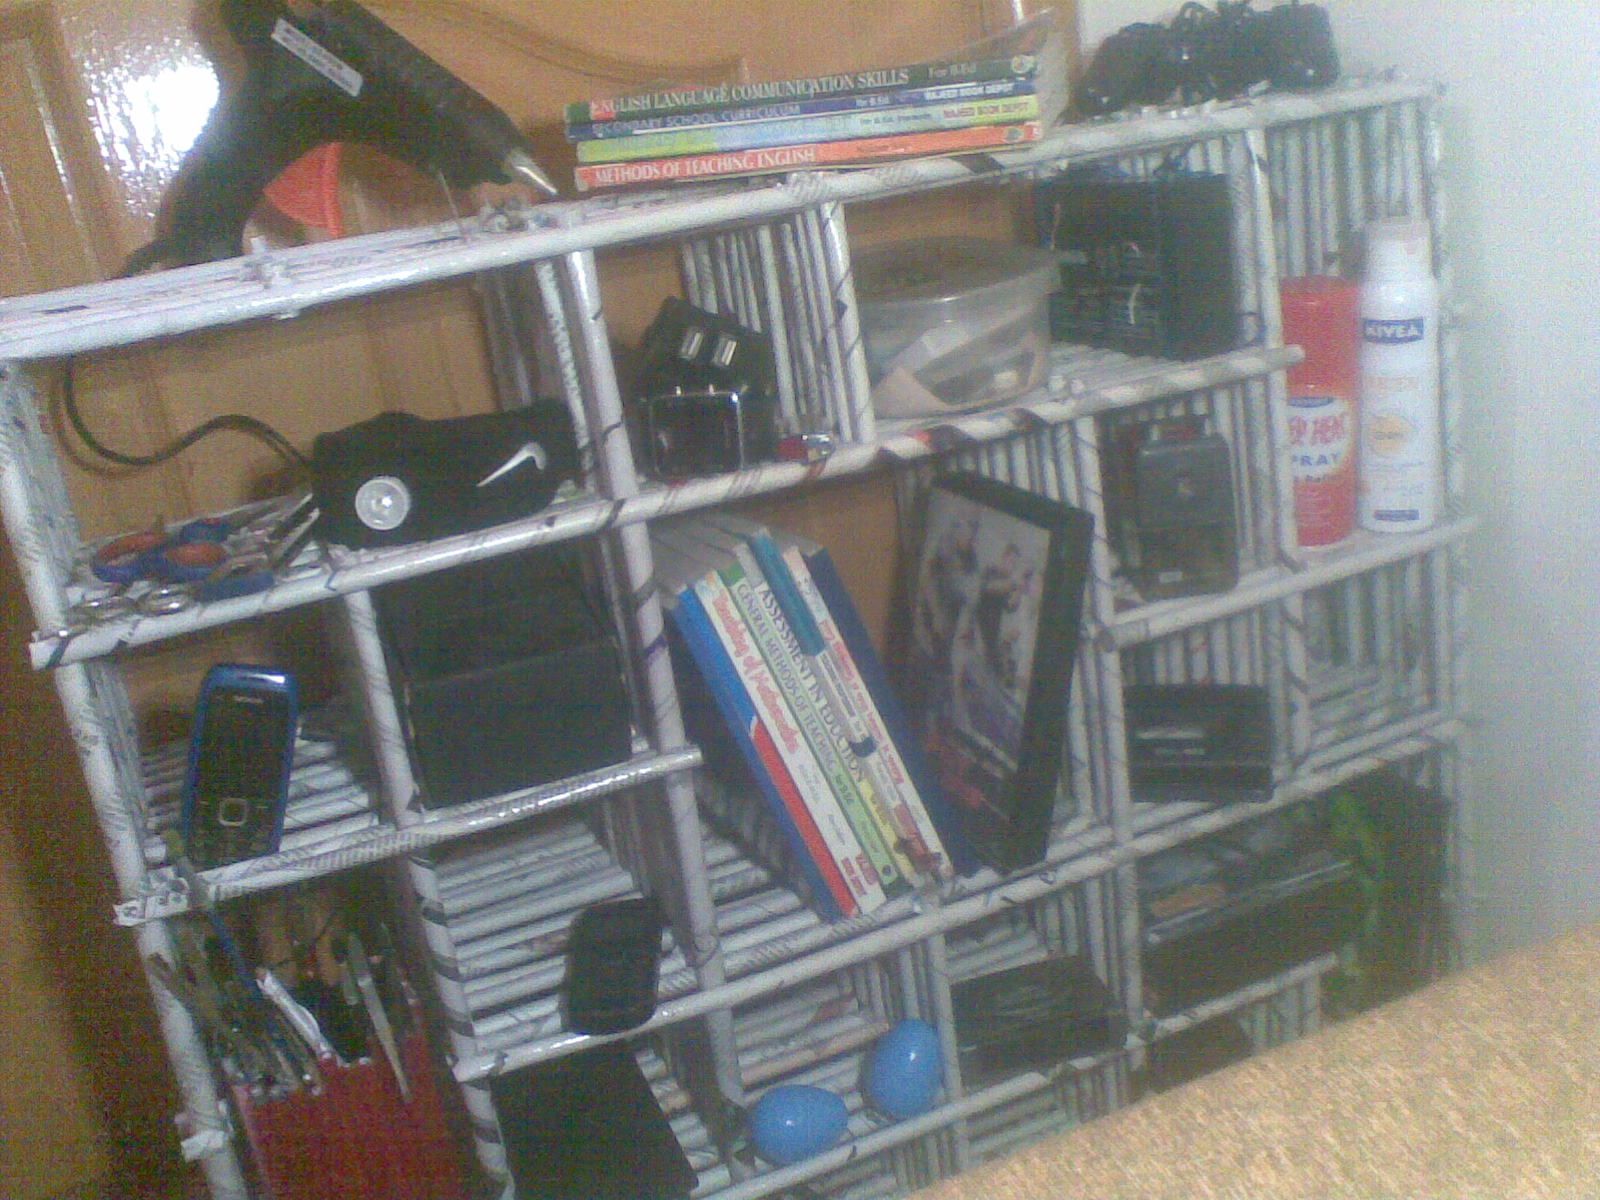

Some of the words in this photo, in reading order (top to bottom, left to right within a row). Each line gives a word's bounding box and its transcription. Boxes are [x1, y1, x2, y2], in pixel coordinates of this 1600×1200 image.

[591, 93, 651, 115] ENGLISH
[654, 85, 729, 110] LANGUAGE
[731, 75, 855, 102] COMMUNICATION
[857, 68, 909, 89] SKILLS
[665, 111, 715, 127] SCHOOL
[720, 104, 800, 123] CURRICULUM
[596, 164, 661, 183] METHODS
[662, 161, 679, 178] OF
[685, 152, 756, 176] TEACHING
[758, 146, 815, 169] ENGLISH
[1366, 323, 1421, 339] NIVEA
[1292, 451, 1341, 466] PRAY
[757, 587, 814, 680] ASSESSMENT
[808, 683, 825, 702] IN
[734, 582, 771, 637] GENERAL
[762, 637, 801, 697] METHODS
[802, 713, 840, 770] TEACHING
